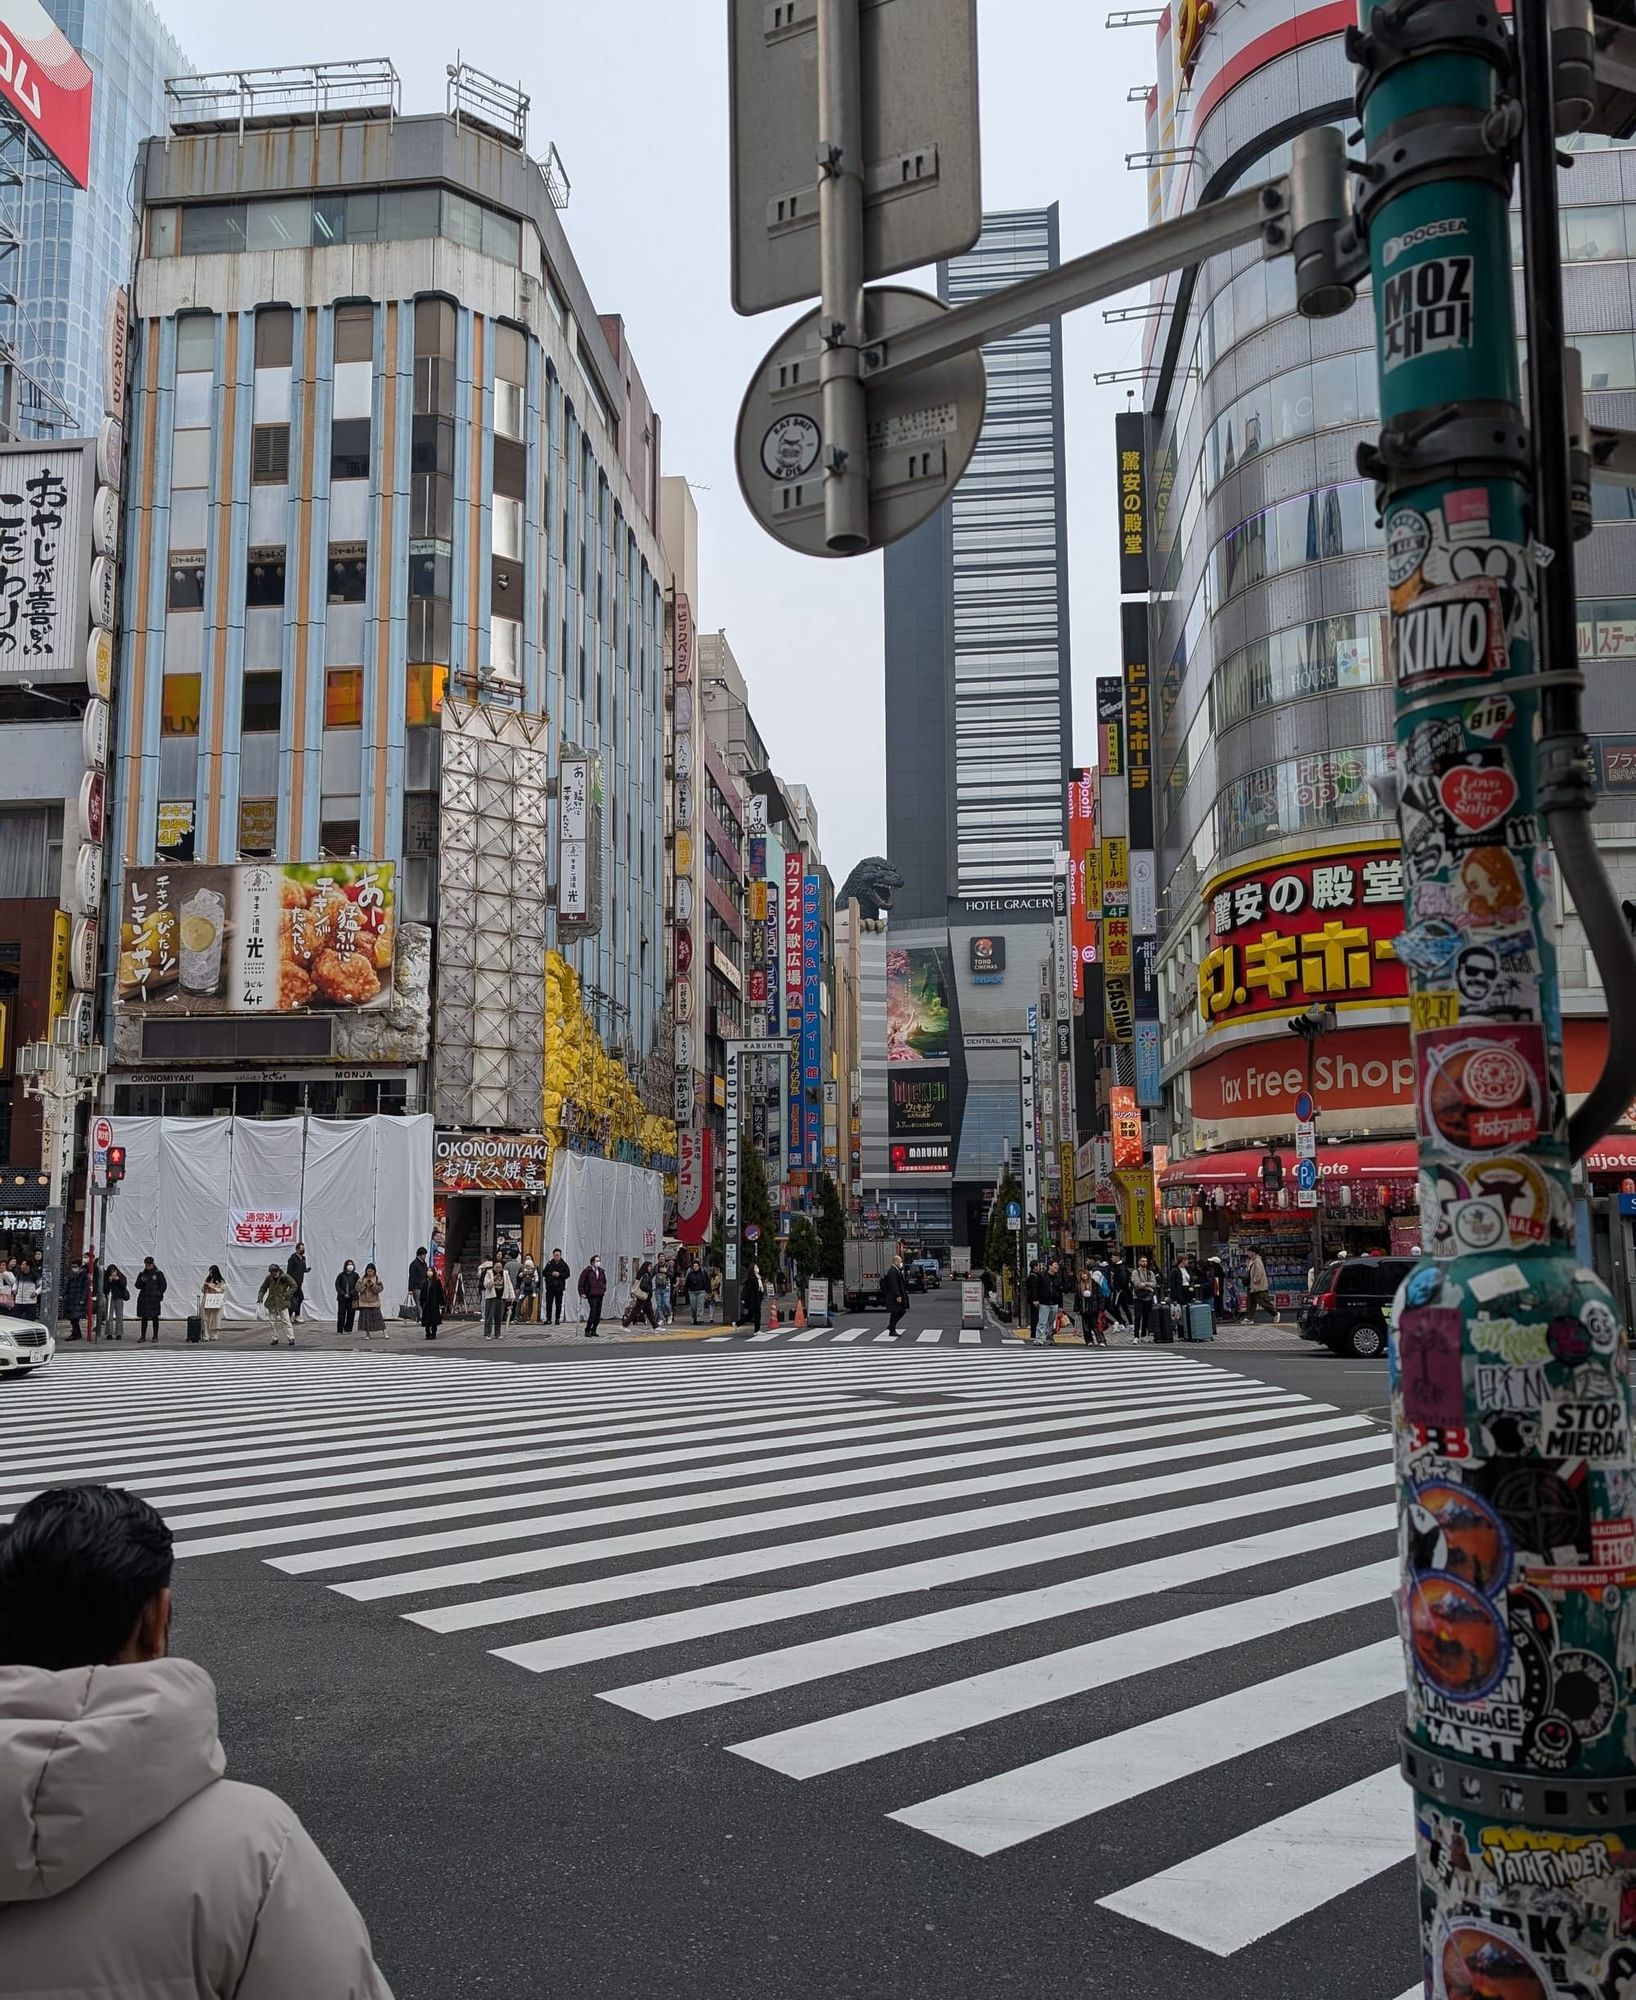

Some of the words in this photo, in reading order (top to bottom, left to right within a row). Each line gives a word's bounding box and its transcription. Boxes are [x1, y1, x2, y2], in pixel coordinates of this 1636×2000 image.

[1385, 258, 1471, 328] MOZ
[773, 418, 791, 436] EAT
[792, 418, 813, 433] SHIT
[785, 465, 804, 478] DIE
[1122, 451, 1143, 555] 驚安の殿堂
[21, 468, 67, 656] おやじが喜ぶ
[1400, 601, 1488, 679] KIMO
[1256, 679, 1283, 704] LIVE
[1290, 665, 1337, 693] HOUSE
[1295, 758, 1362, 786] Free
[753, 801, 763, 827] ダーツ
[1109, 841, 1120, 878] 生ビール
[314, 877, 334, 937] チキンが
[568, 890, 578, 903] 光
[966, 900, 1002, 911] HOTEL
[1004, 898, 1055, 910] GRACERY
[786, 857, 802, 985] カラオケ歌広場
[1109, 906, 1127, 917] 4F
[130, 881, 153, 1003] レモンサワー
[291, 906, 312, 960] たべたい。
[1108, 920, 1129, 957] 麻雀
[246, 937, 264, 959] 光
[243, 989, 263, 1006] 4F
[1106, 977, 1133, 1038] CASINO
[131, 1073, 194, 1083] OKONOMIYAKI
[335, 1070, 374, 1079] MONJA
[1221, 1074, 1241, 1107] Tax
[1246, 1066, 1304, 1101] Free
[1314, 1054, 1416, 1095] Shop
[892, 1080, 947, 1106] WICKED
[727, 1068, 737, 1157] GODZILLA
[1120, 1121, 1136, 1130] 飲み
[437, 1141, 548, 1161] OKONOMIYAKI
[681, 1133, 692, 1186] トラノコ
[909, 1146, 948, 1158] MARUHAN
[442, 1160, 540, 1180] お好み焼き
[1123, 1174, 1150, 1183] カラオケ
[727, 1167, 737, 1211] ROAD
[245, 1212, 283, 1222] 通常通り
[236, 1223, 292, 1244] 営業中
[1556, 1404, 1622, 1430] STOP
